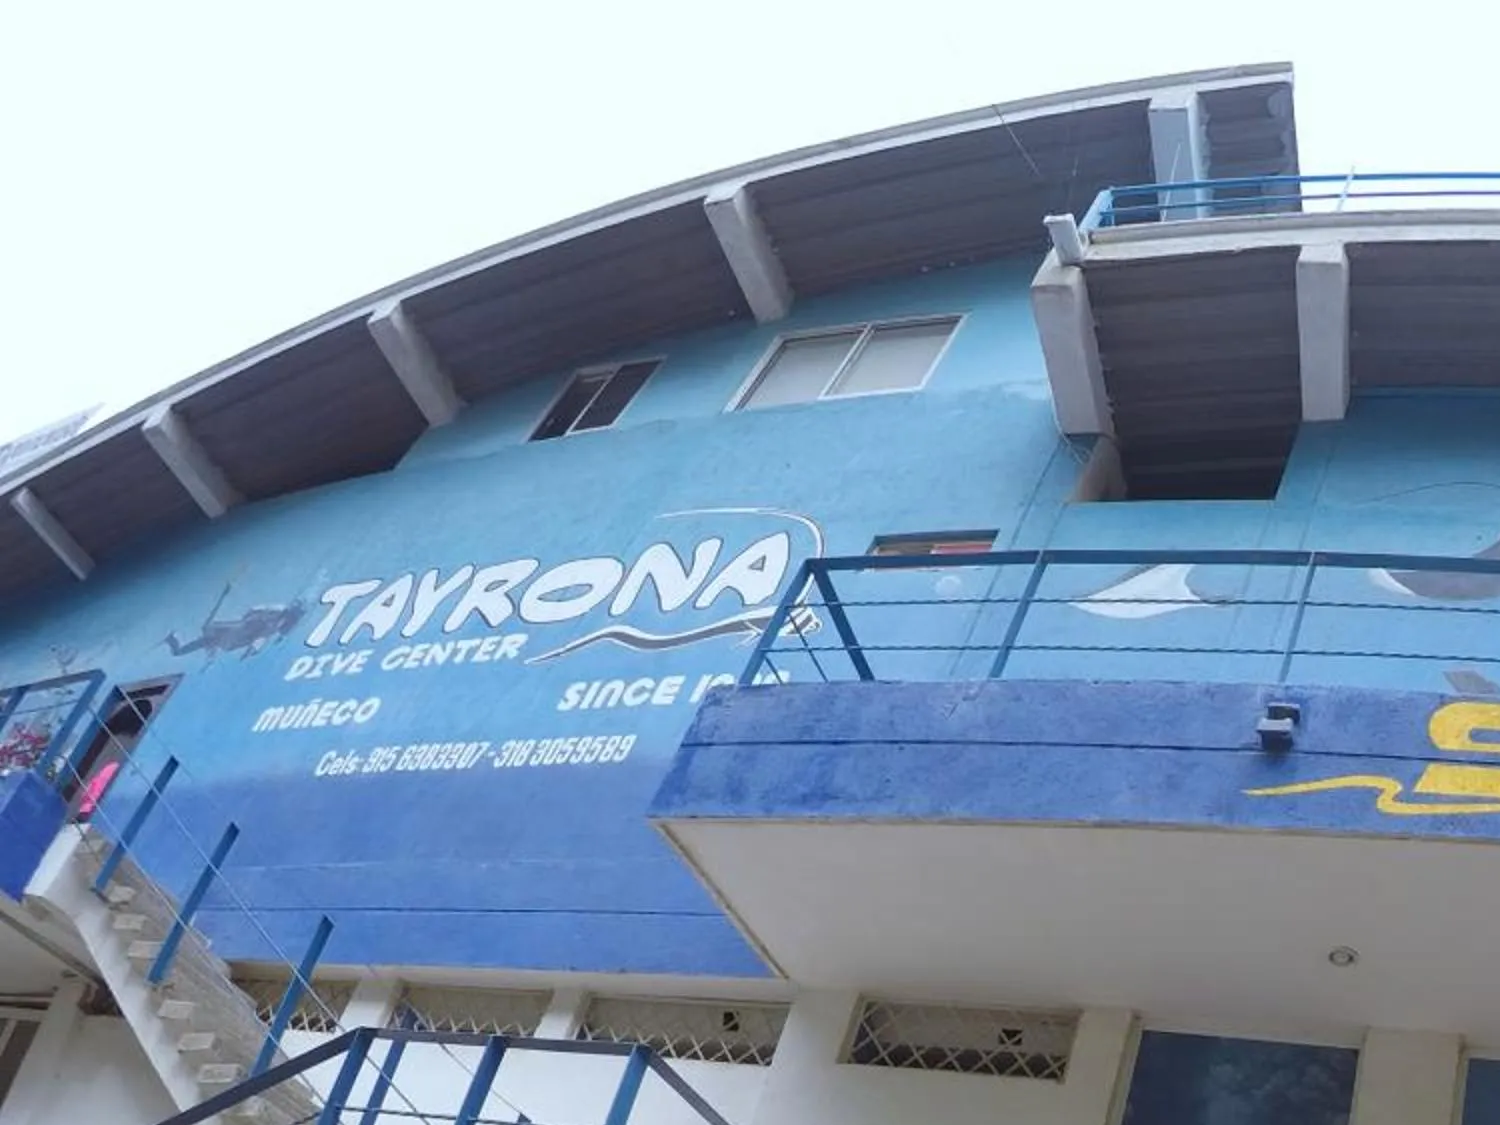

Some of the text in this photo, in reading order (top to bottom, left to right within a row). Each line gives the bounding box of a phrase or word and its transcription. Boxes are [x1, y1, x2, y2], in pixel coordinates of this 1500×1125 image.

[305, 531, 790, 648] TAYRONA
[283, 633, 529, 682] DIVE CENTER
[557, 674, 686, 711] SINCE
[252, 697, 382, 733] MUÑECO
